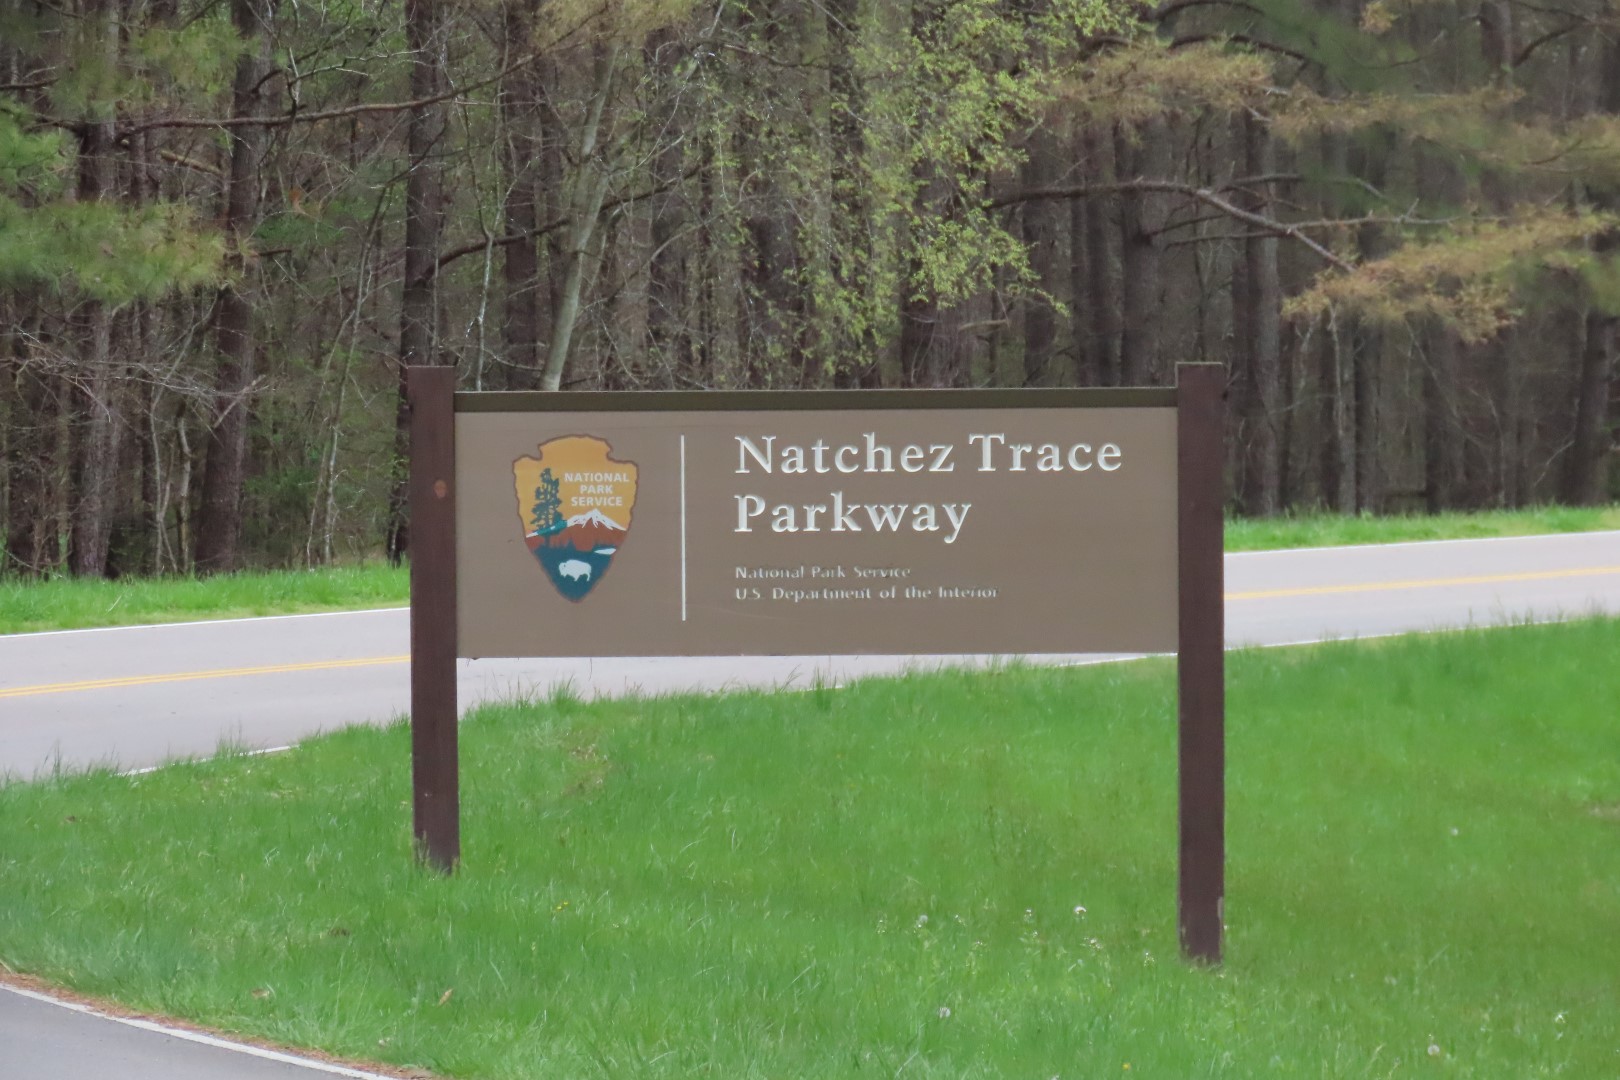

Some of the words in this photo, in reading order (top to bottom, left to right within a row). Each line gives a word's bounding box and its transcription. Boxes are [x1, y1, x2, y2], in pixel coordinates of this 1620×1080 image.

[734, 432, 955, 474] Natchez
[968, 432, 1123, 472] Trace
[564, 472, 630, 482] NATIONAL
[580, 484, 614, 494] PARK
[571, 496, 622, 506] SERVICE
[733, 490, 972, 544] Parkway
[735, 566, 804, 579] National
[812, 566, 846, 578] Park
[854, 566, 911, 579] Service
[772, 587, 871, 603] Department
[879, 586, 896, 599] of
[905, 587, 932, 599] the
[938, 586, 999, 599] Interior
